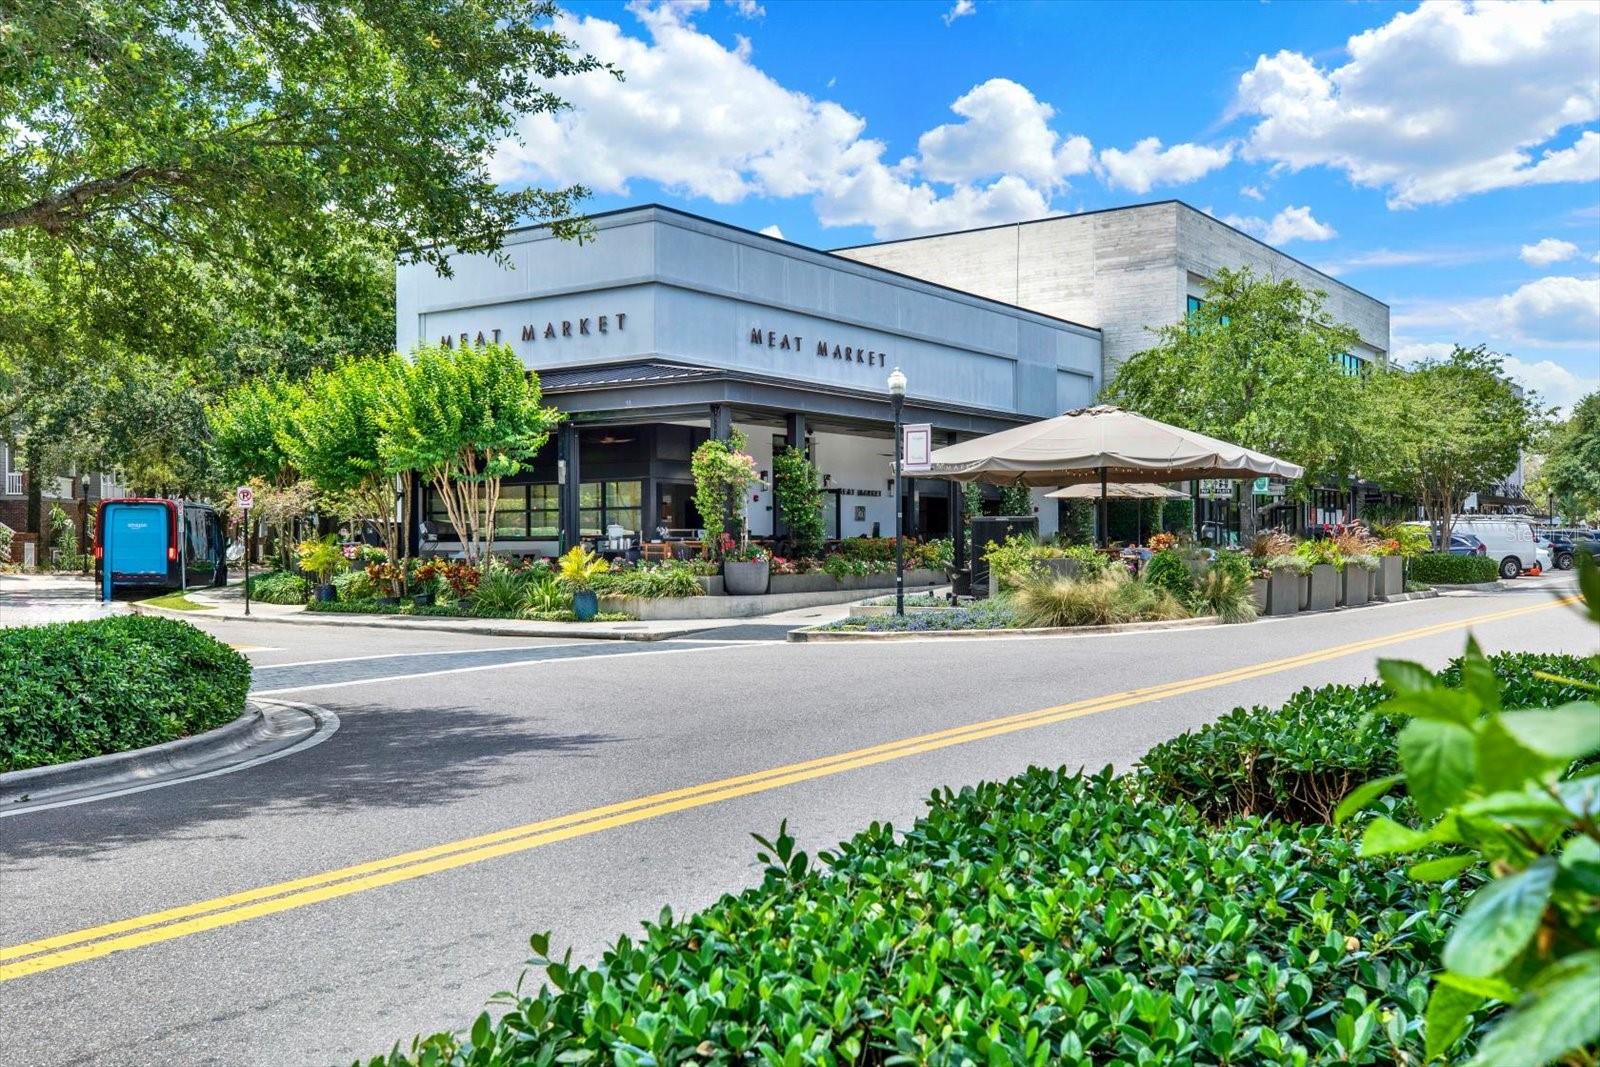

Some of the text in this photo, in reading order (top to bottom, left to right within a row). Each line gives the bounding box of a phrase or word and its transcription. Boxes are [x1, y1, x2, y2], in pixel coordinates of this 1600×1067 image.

[522, 313, 626, 341] MARKET
[750, 327, 886, 367] MEAT MARKET
